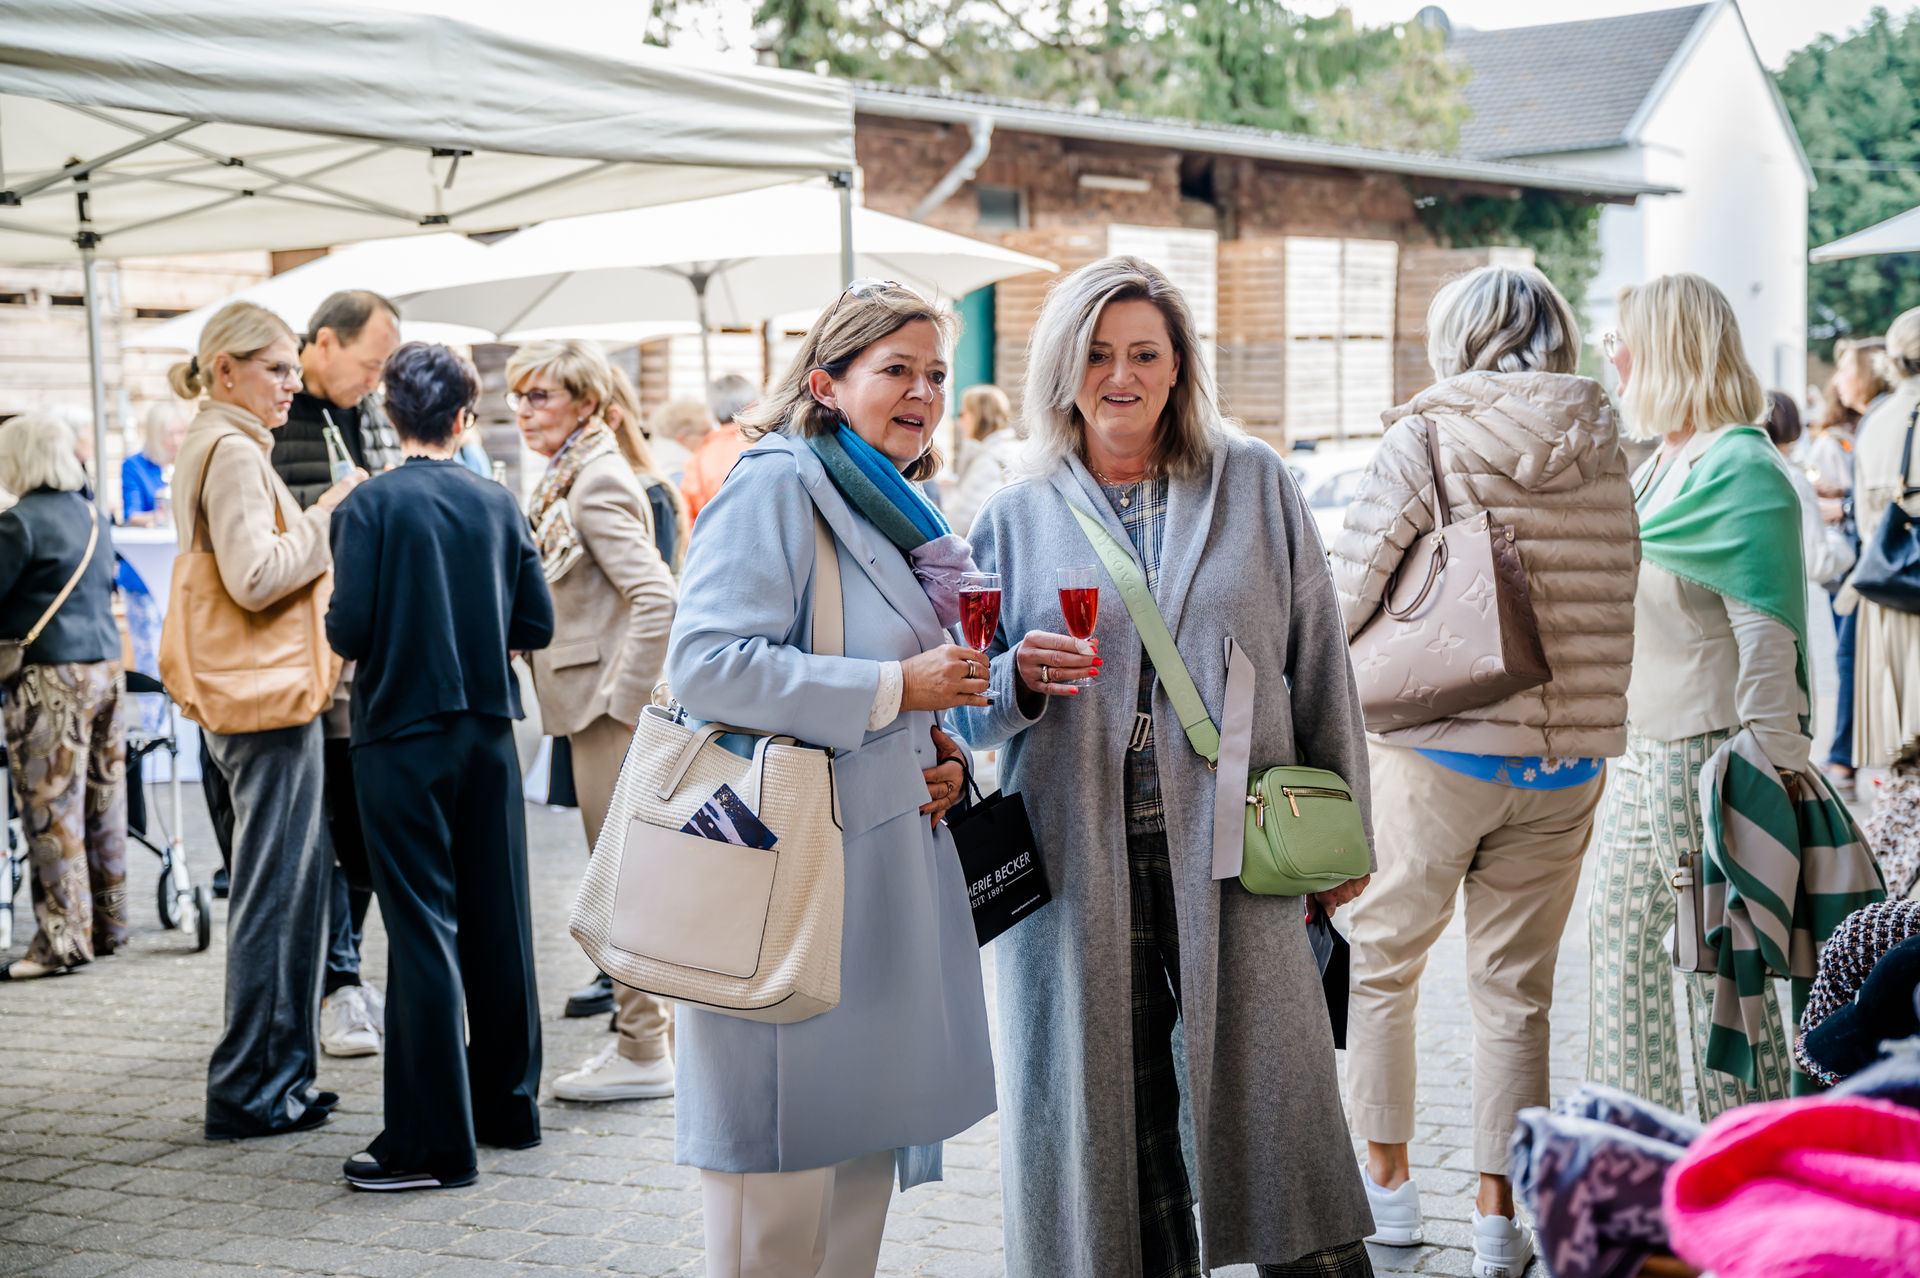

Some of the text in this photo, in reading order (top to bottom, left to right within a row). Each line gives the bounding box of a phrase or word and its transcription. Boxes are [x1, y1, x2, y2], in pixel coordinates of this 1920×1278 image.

[994, 851, 1031, 883] BECKER
[970, 884, 1004, 909] EIT 1897
